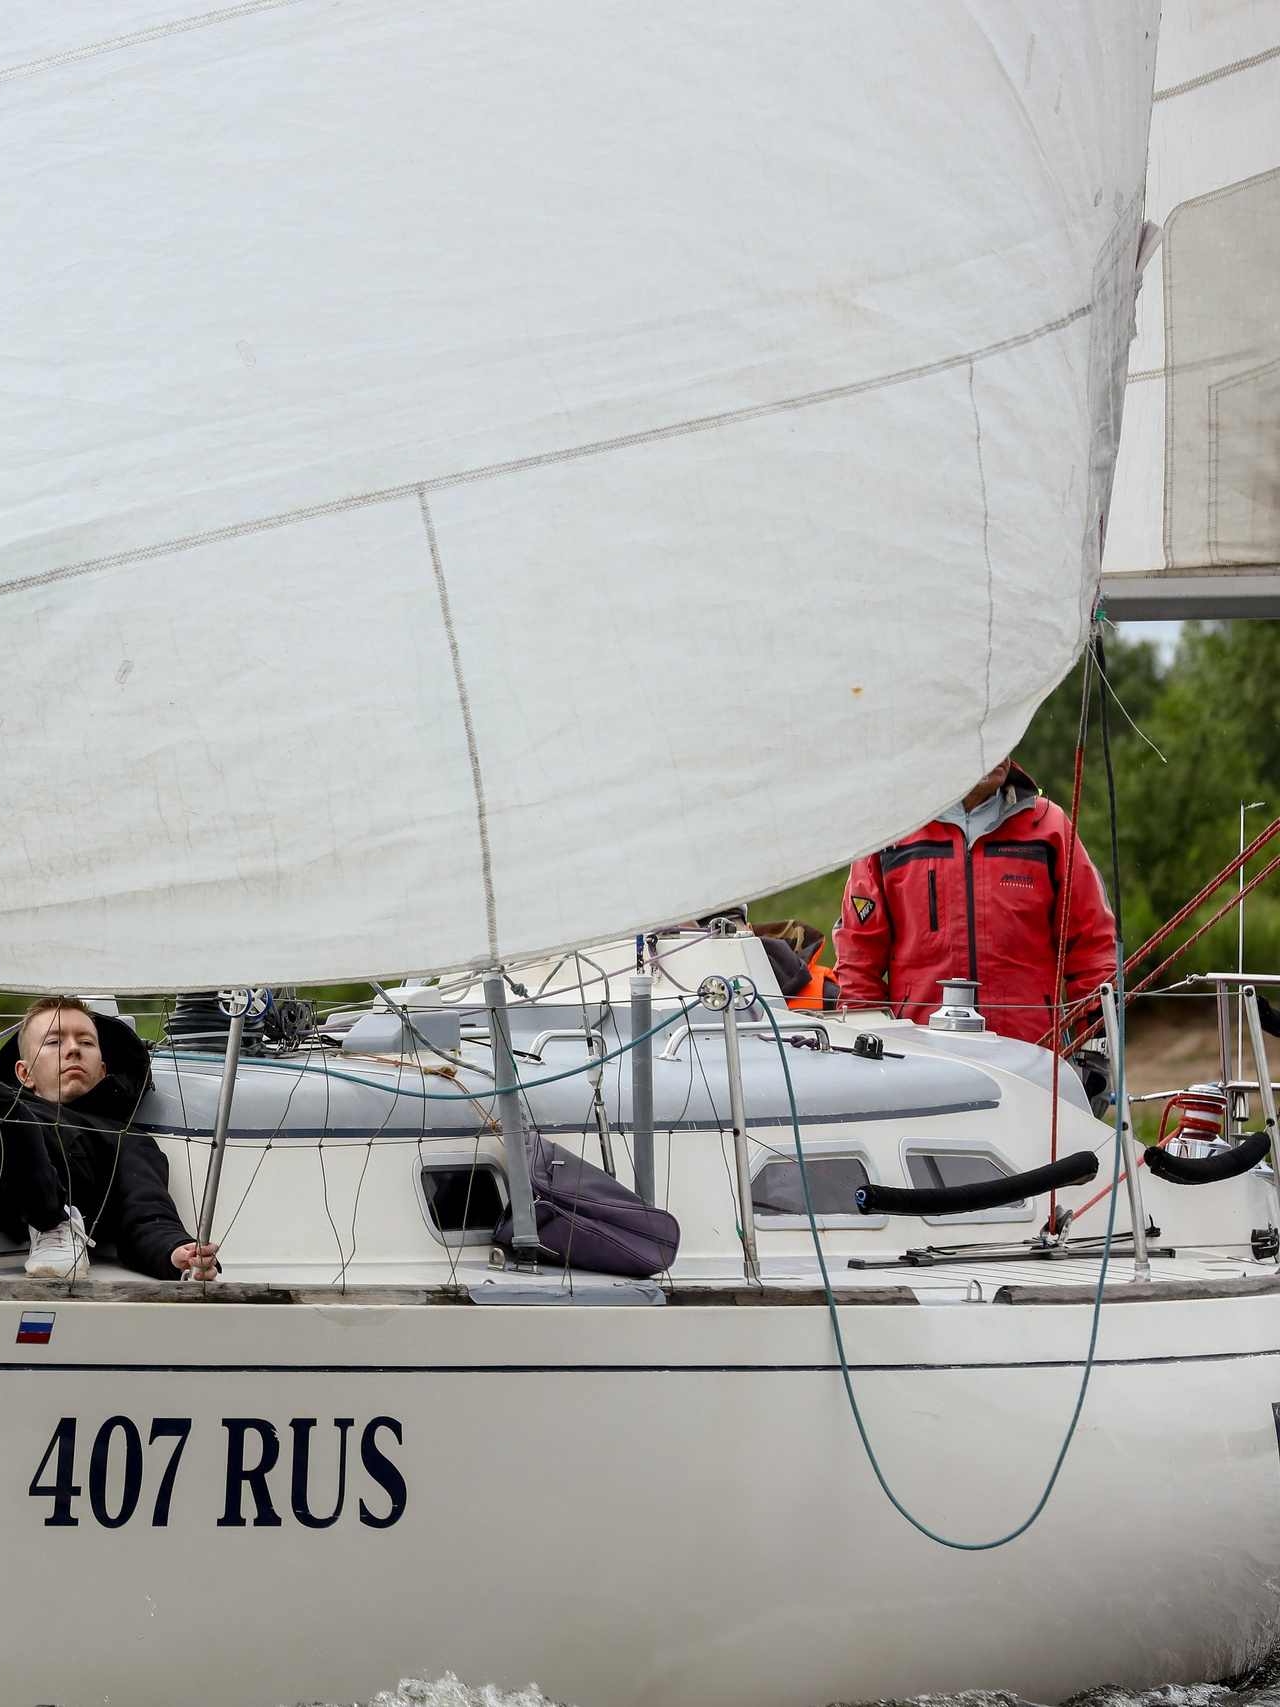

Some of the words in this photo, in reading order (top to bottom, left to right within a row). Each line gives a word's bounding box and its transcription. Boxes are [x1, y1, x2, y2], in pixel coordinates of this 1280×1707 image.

[1000, 873, 1034, 883] MUSTO
[28, 1414, 193, 1529] 407
[216, 1414, 408, 1529] RUS
